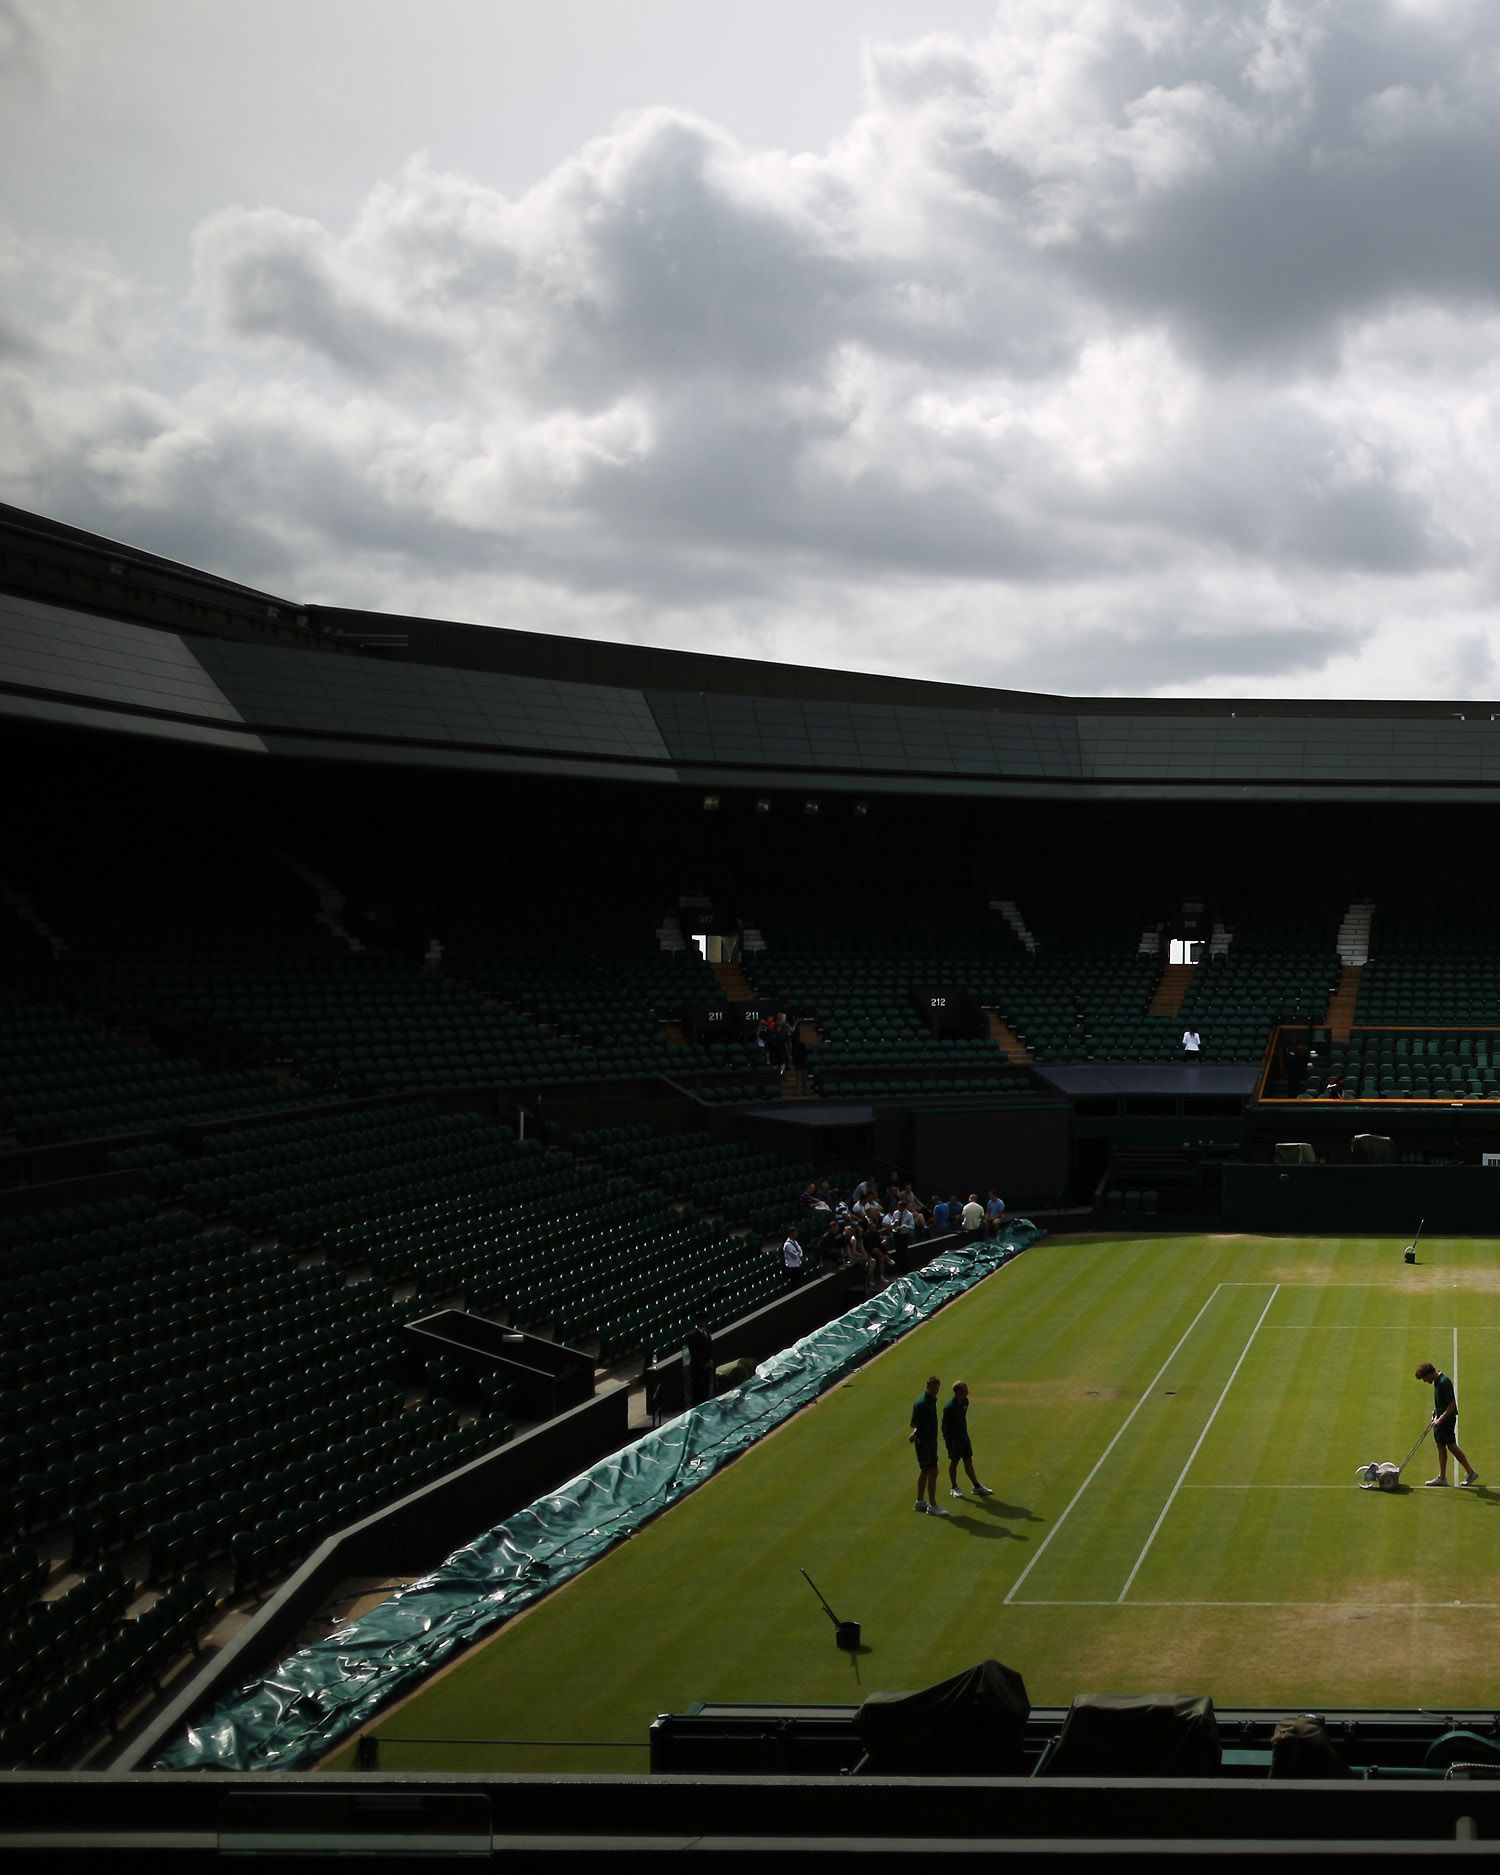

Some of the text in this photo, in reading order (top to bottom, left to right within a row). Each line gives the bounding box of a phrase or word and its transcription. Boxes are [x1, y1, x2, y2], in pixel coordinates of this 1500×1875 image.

[931, 998, 946, 1006] 212
[709, 1012, 722, 1020] 211
[746, 1012, 759, 1020] 211
